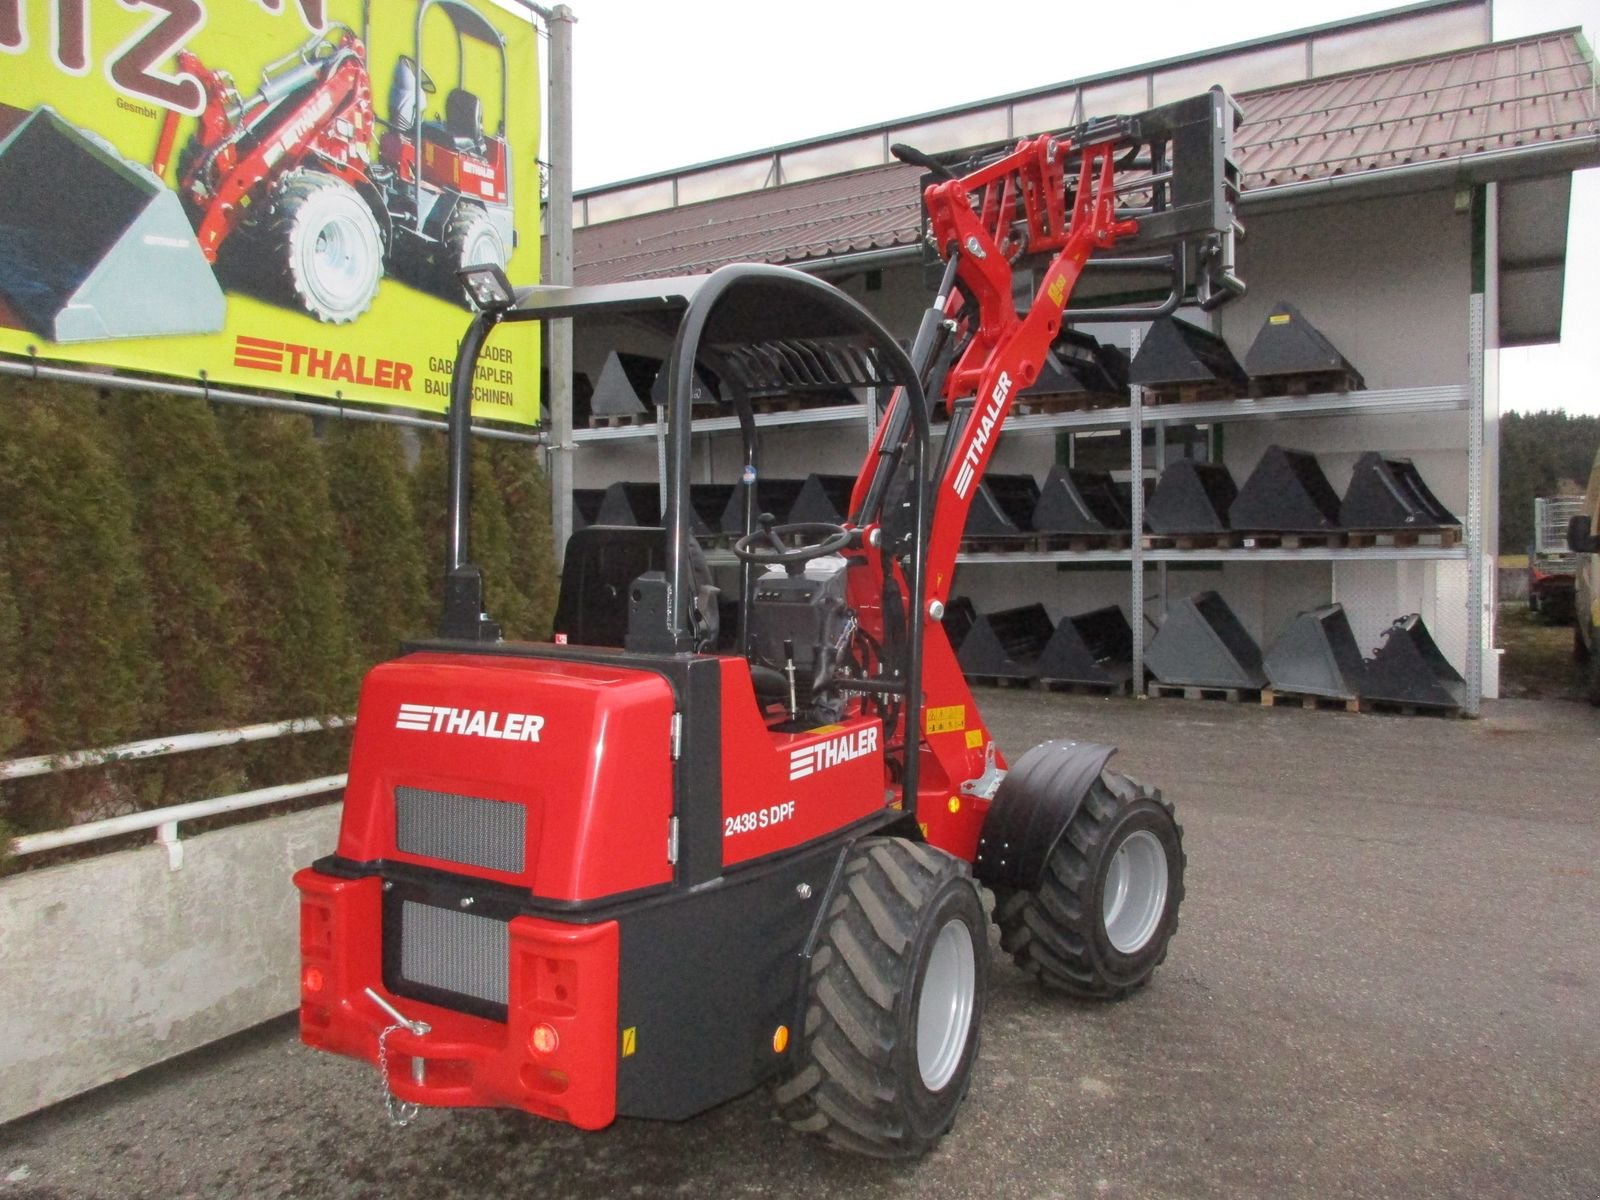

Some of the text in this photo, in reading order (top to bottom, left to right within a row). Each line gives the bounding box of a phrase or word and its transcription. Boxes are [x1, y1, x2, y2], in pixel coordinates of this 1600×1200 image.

[116, 97, 158, 120] GesmbH
[285, 342, 413, 392] THALER
[428, 356, 513, 385] GABTAPLER
[965, 370, 1013, 466] THALER
[432, 706, 545, 743] THALER
[813, 726, 878, 772] THALER
[725, 800, 796, 837] 2438 S DPF
